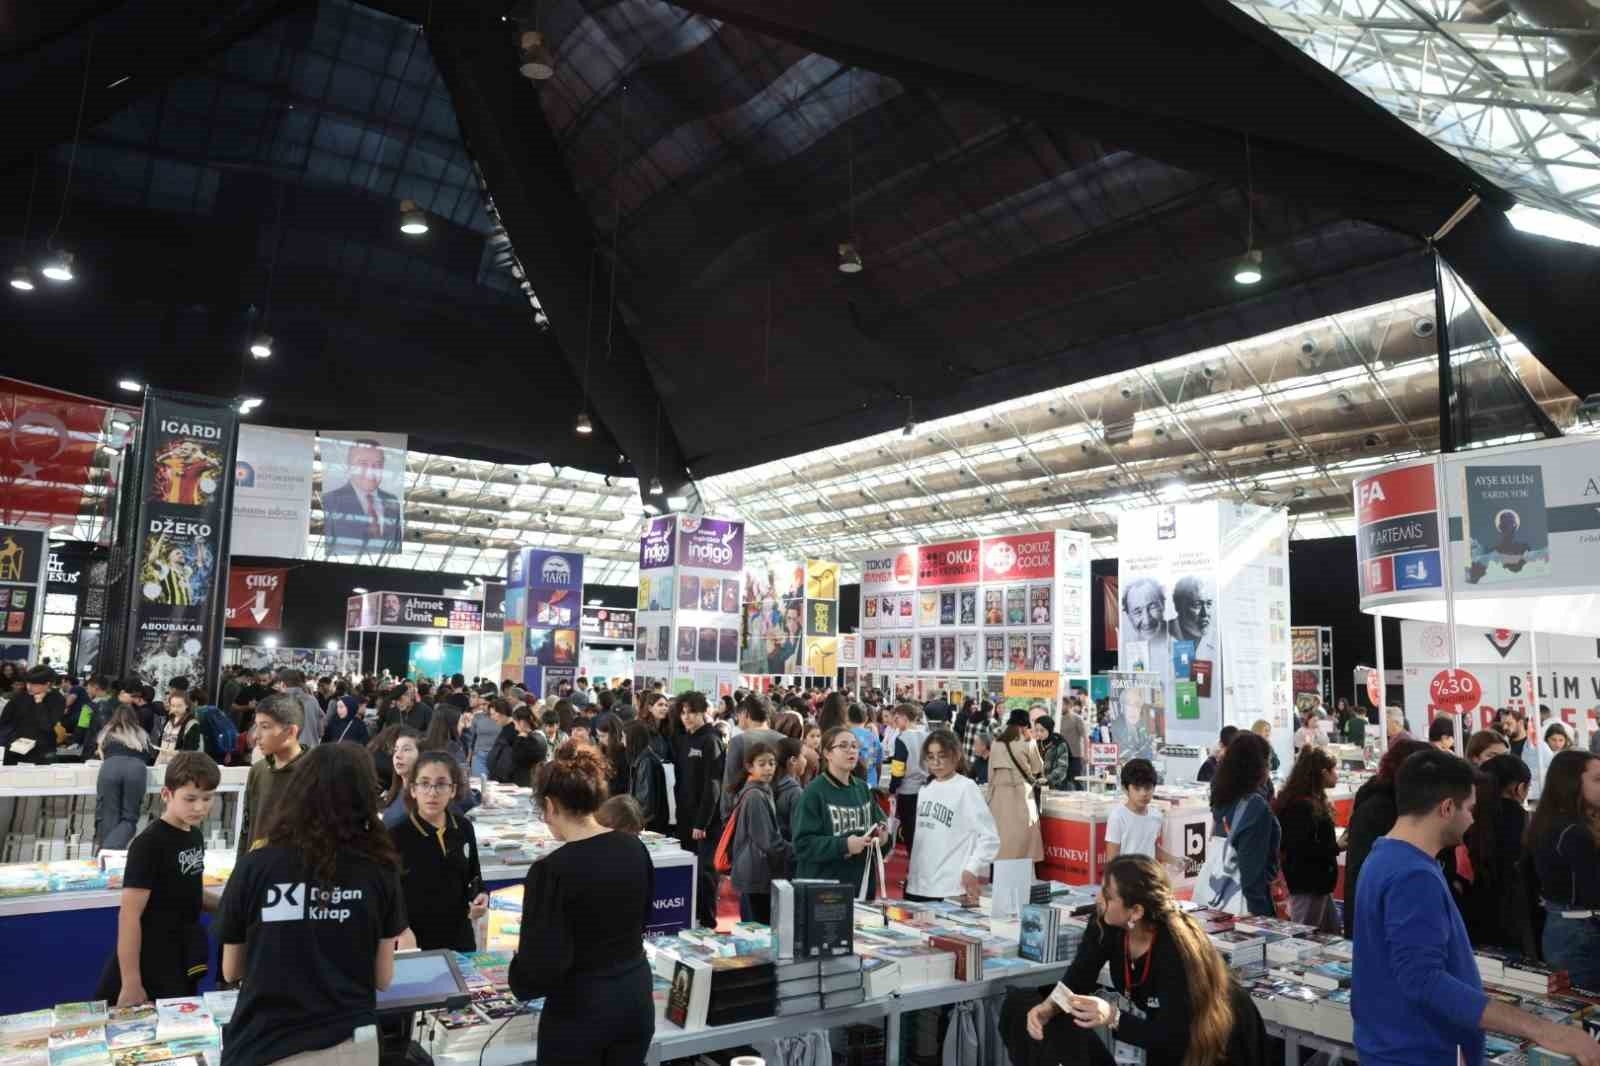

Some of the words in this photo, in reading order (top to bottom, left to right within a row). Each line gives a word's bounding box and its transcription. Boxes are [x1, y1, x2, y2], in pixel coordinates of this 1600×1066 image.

[160, 419, 222, 440] ICARDI
[149, 519, 212, 537] DŽEKO
[688, 540, 733, 565] indigo
[246, 575, 278, 591] ÇIKIŞ
[405, 597, 444, 611] Ahmet
[404, 607, 433, 623] Ümit
[1432, 677, 1473, 695] %30
[827, 801, 871, 837] BERLI
[932, 803, 955, 829] SIDE
